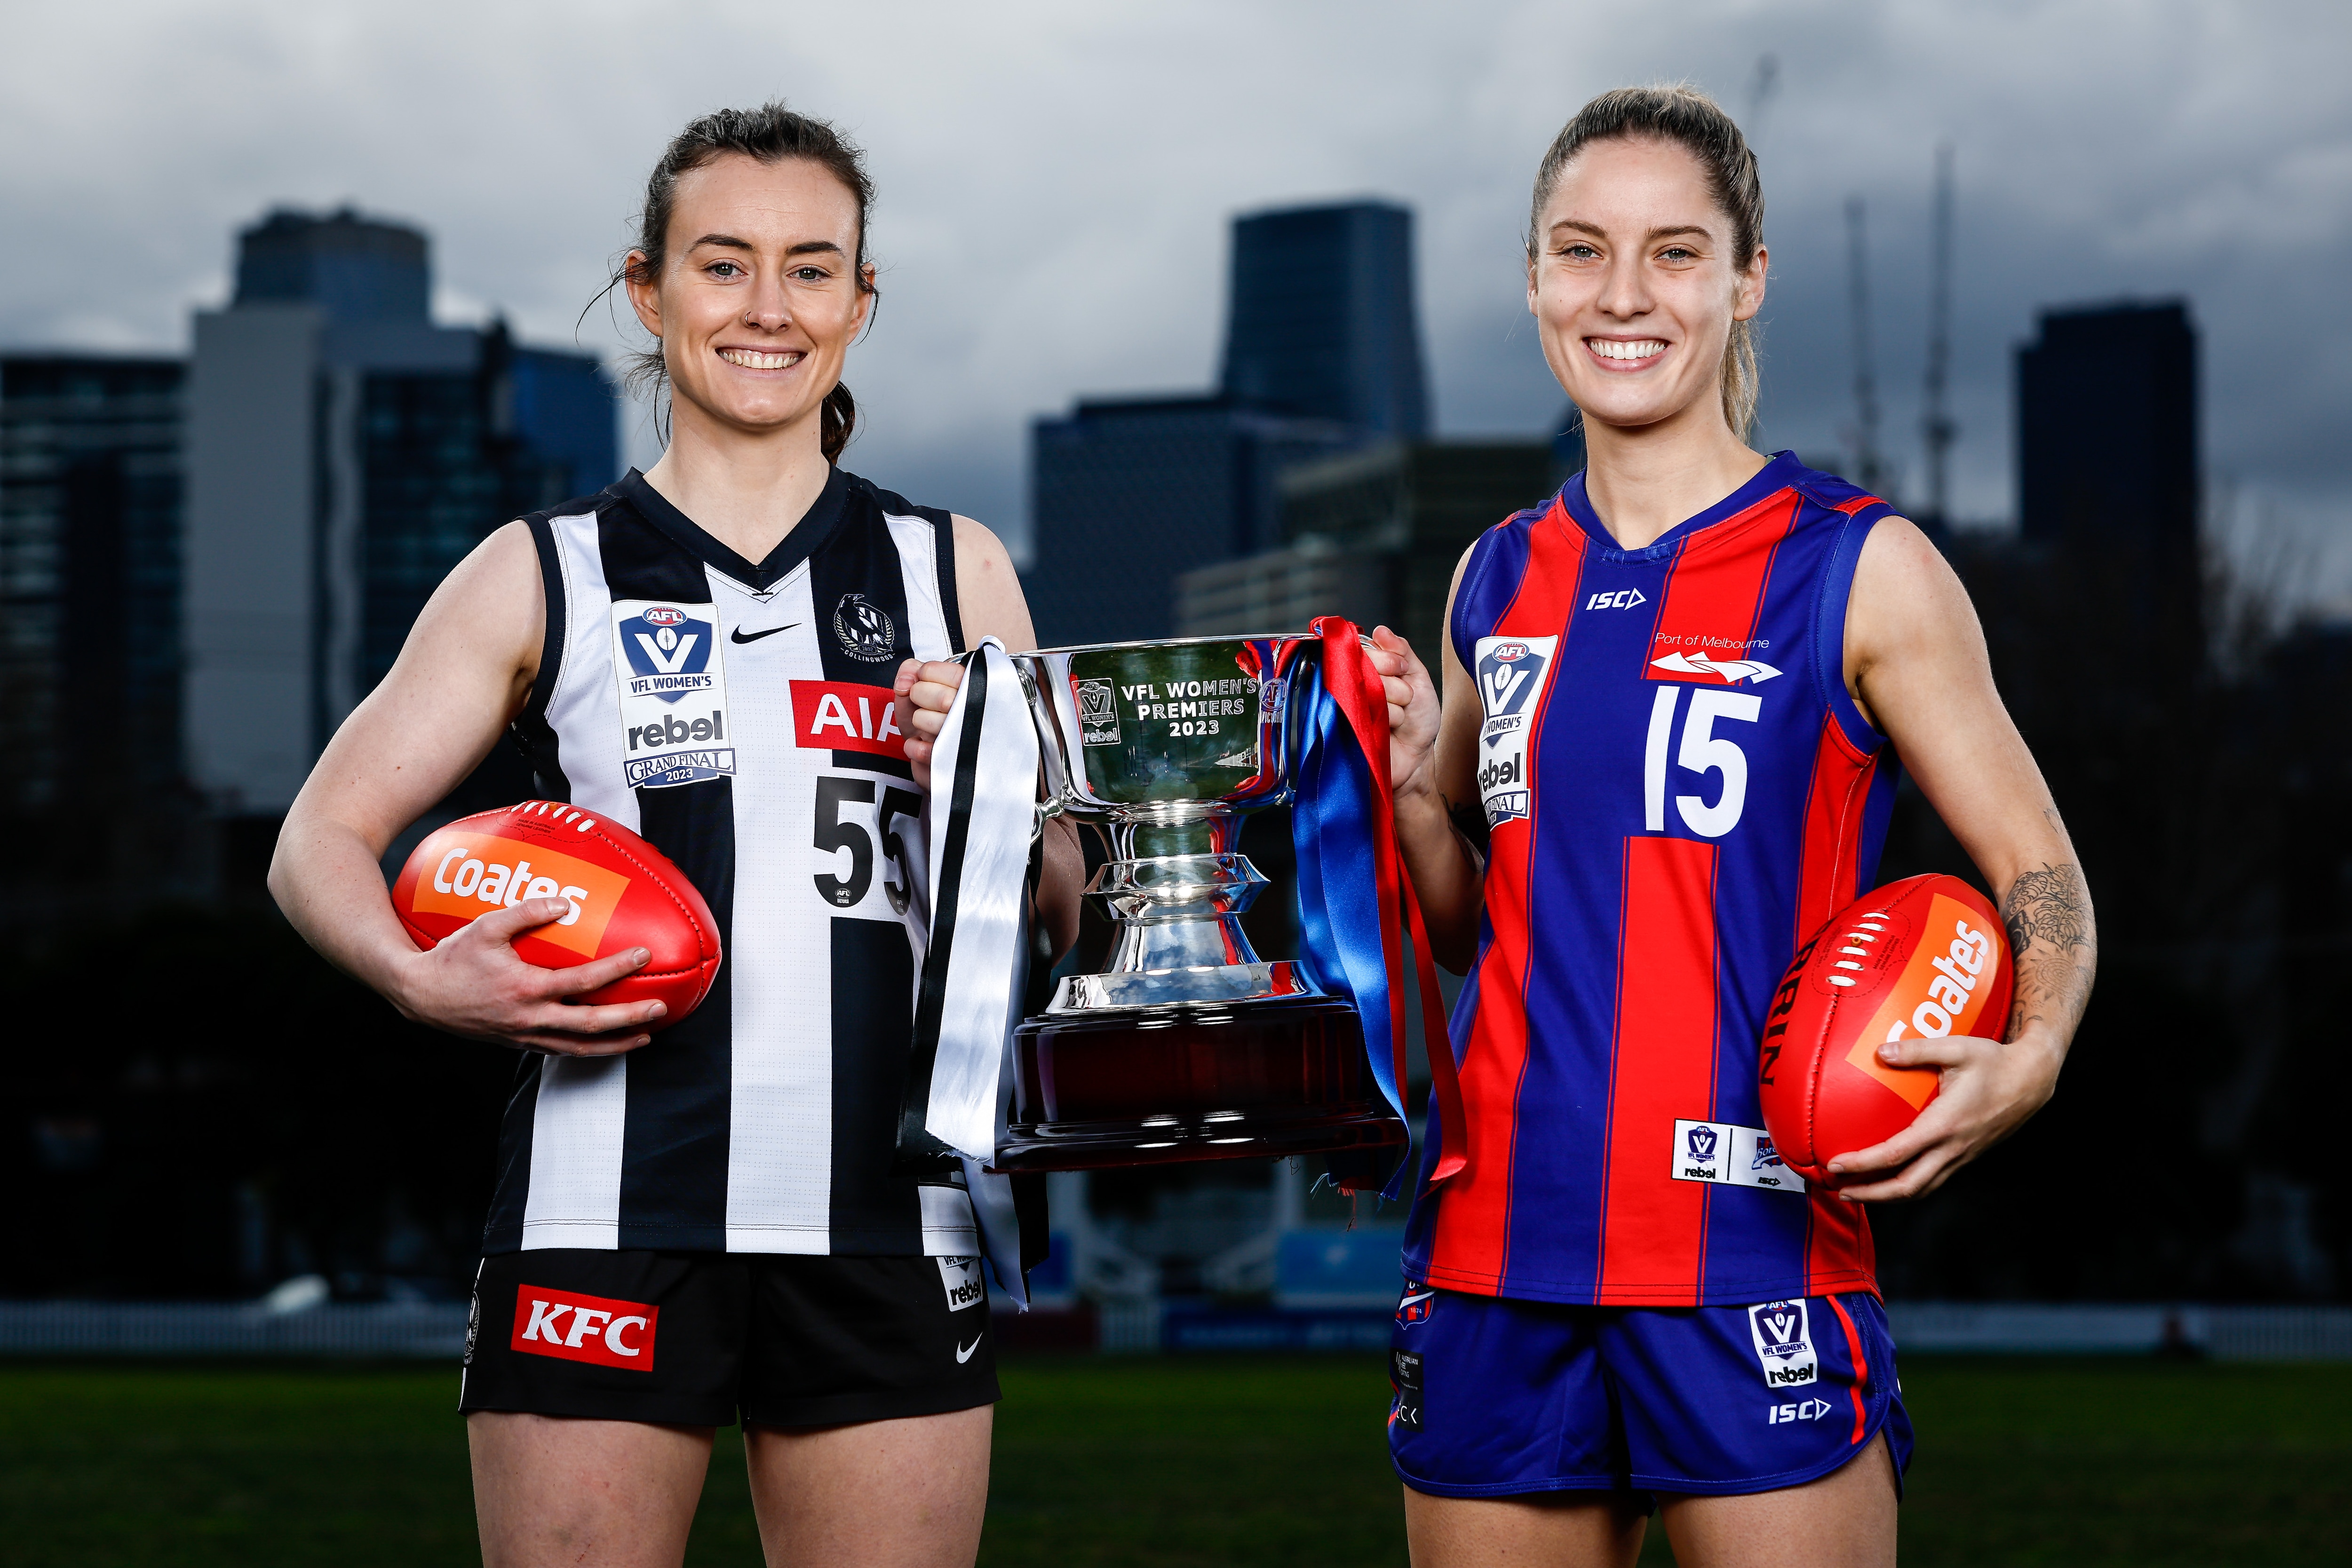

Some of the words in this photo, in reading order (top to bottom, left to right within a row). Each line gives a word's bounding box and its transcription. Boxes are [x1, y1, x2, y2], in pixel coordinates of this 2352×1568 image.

[1586, 590, 1630, 610] ISC
[647, 611, 683, 622] AFL
[1495, 646, 1526, 657] AFL
[1654, 632, 1681, 645] Port
[1685, 635, 1700, 646] of
[1701, 636, 1770, 649] Melbourne
[634, 633, 699, 674] V
[844, 649, 893, 663] COLLINGWOOD
[631, 678, 651, 693] VFL
[653, 675, 712, 689] WOMEN'S
[1121, 684, 1160, 701] VFL
[1166, 678, 1257, 698] WOMEN'S
[1261, 685, 1286, 703] AFL
[1483, 670, 1531, 715] V
[1138, 698, 1244, 721] PREMIERS
[628, 710, 723, 751] rebel
[1084, 728, 1118, 743] rebel
[1169, 720, 1220, 737] 2023
[629, 756, 676, 781] GRAND
[678, 752, 731, 770] FINAL
[1644, 685, 1763, 838] 15
[666, 768, 694, 782] 2023
[1492, 795, 1524, 812] FINAL
[813, 776, 923, 917] 55
[434, 847, 588, 926] Coates
[1760, 915, 1835, 1086] RRIN
[1685, 1166, 1716, 1179] rebel
[950, 1274, 982, 1306] rebel
[1768, 1301, 1787, 1309] AFL
[522, 1300, 647, 1356] KFC
[1763, 1315, 1796, 1344] V
[1762, 1346, 1775, 1356] VFL
[1776, 1341, 1807, 1354] WOMEN'S
[1769, 1363, 1813, 1385] rebel
[1769, 1400, 1814, 1425] ISC
